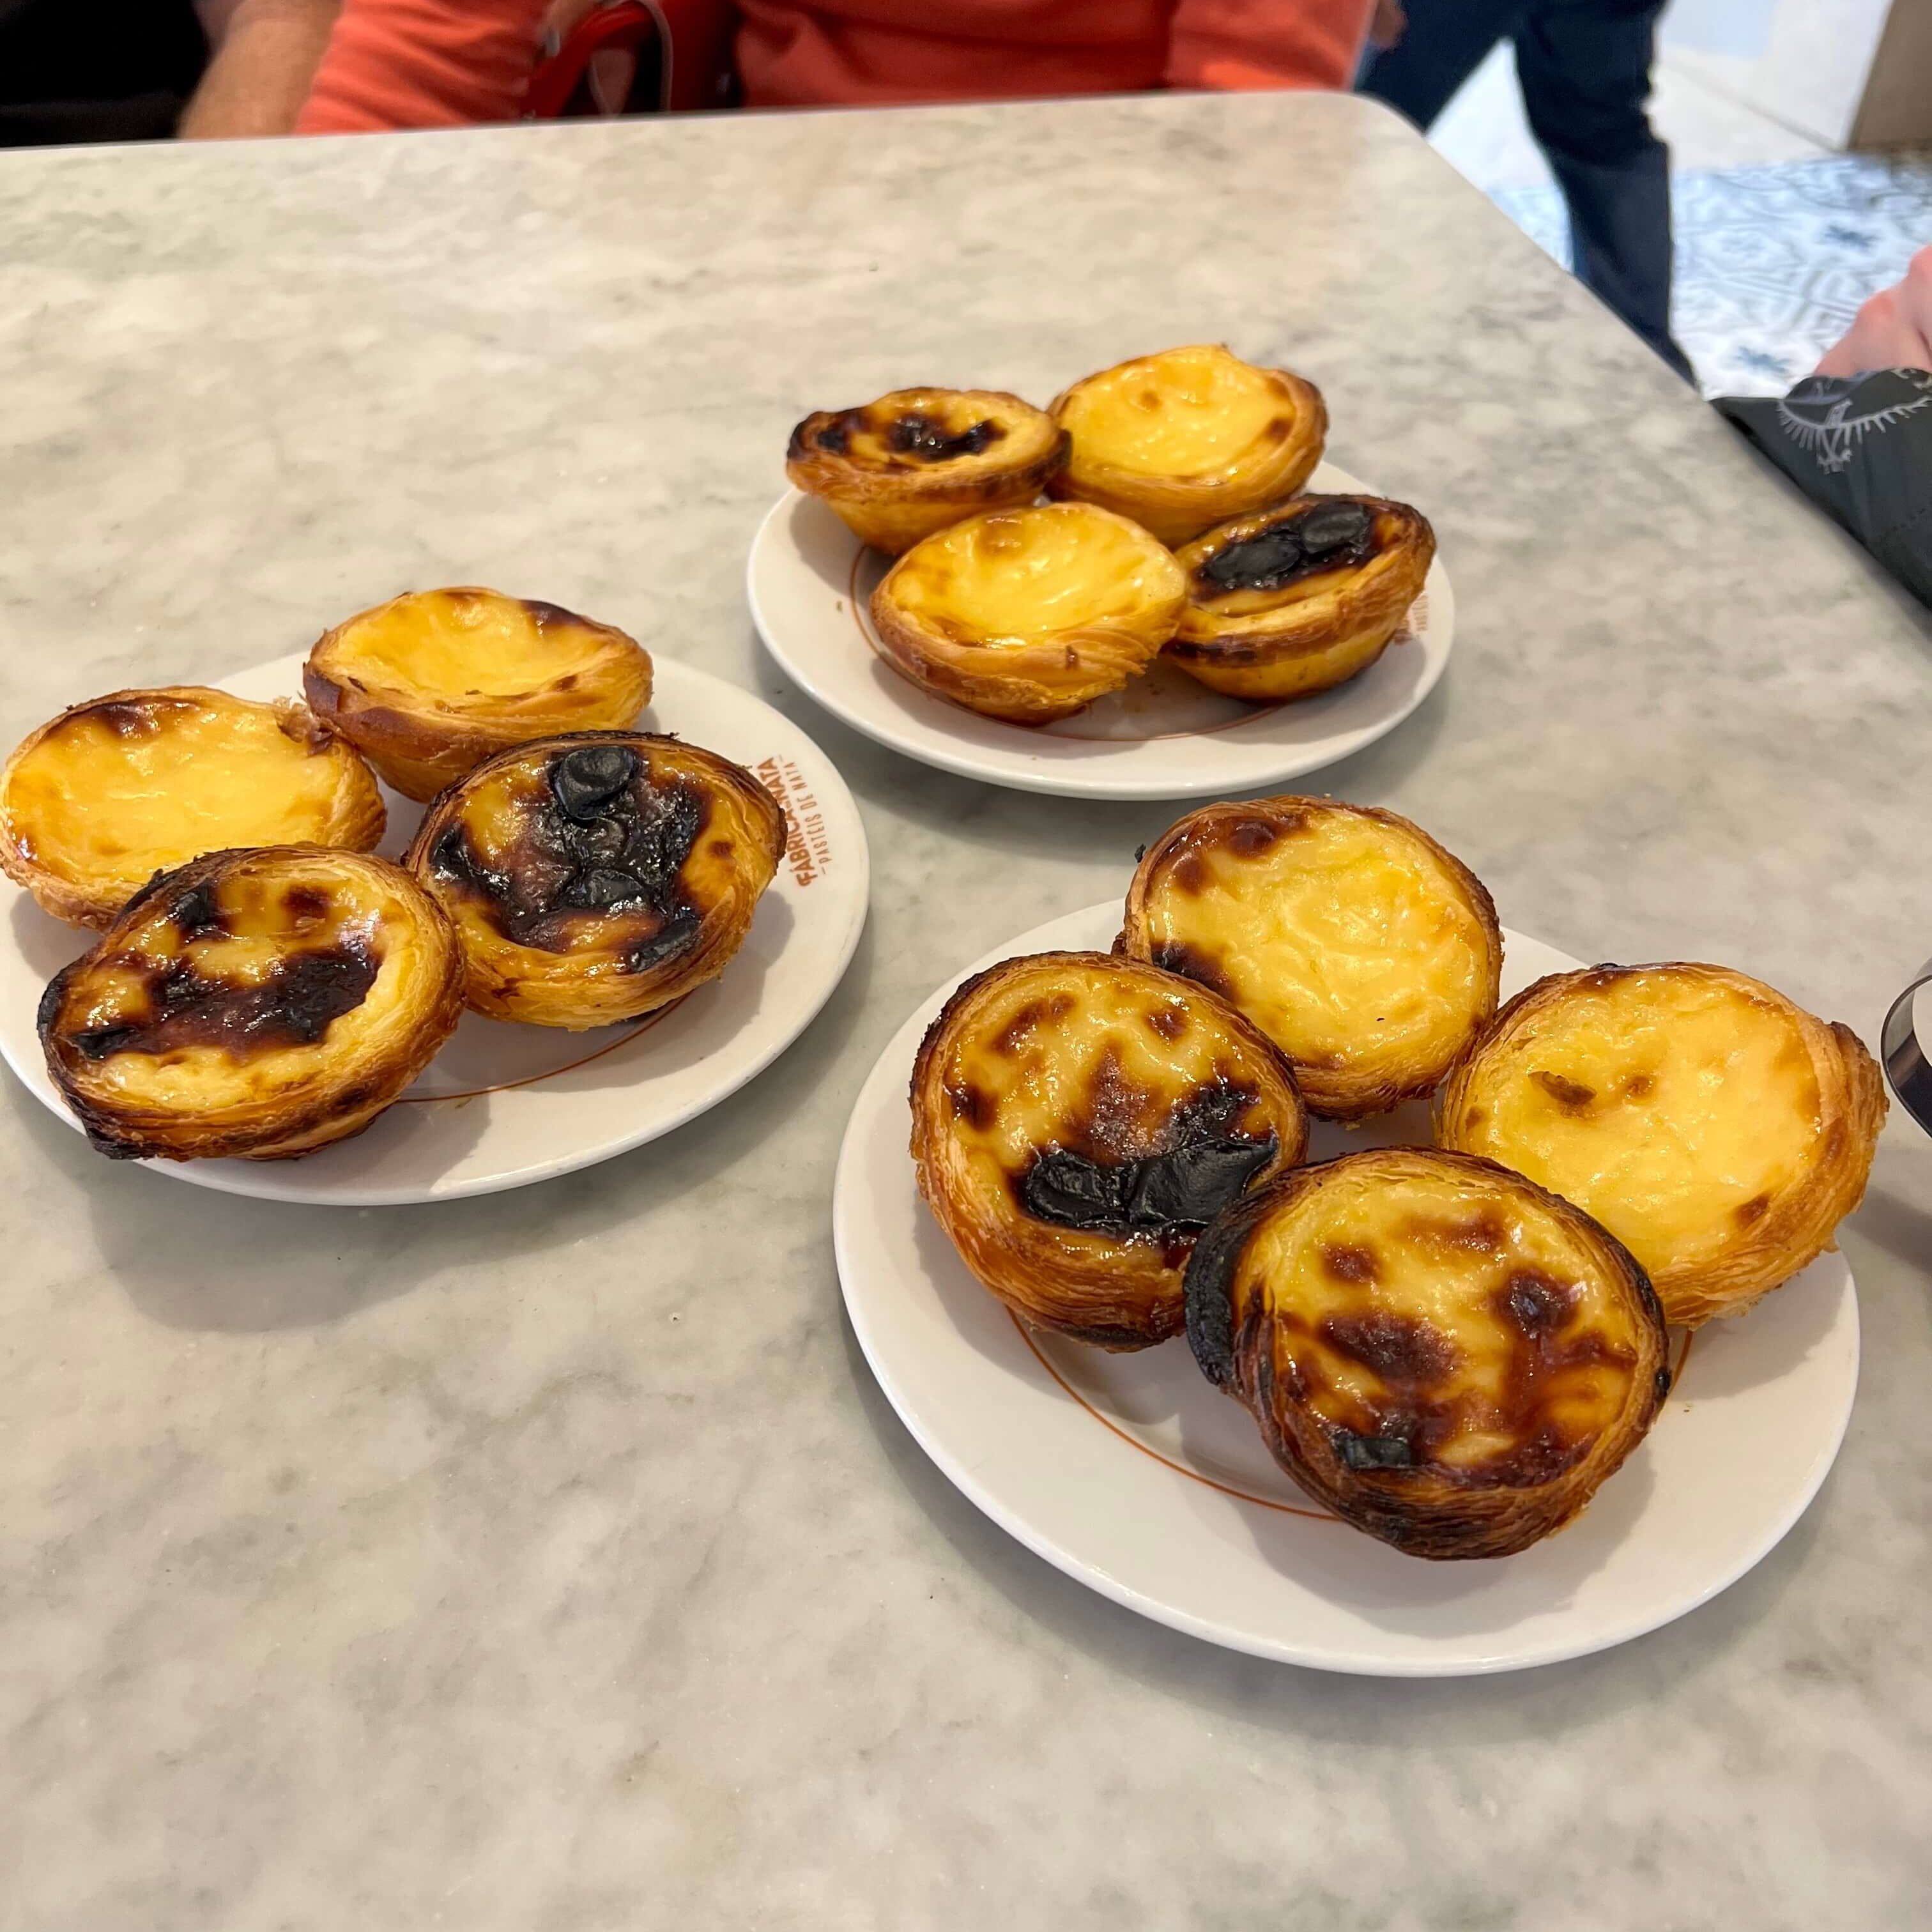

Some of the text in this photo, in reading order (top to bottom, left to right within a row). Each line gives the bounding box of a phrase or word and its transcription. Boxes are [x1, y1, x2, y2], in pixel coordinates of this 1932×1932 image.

[756, 756, 788, 800] NATA
[783, 762, 808, 791] NATA
[797, 793, 818, 811] DE
[804, 813, 832, 864] PASTÉIS
